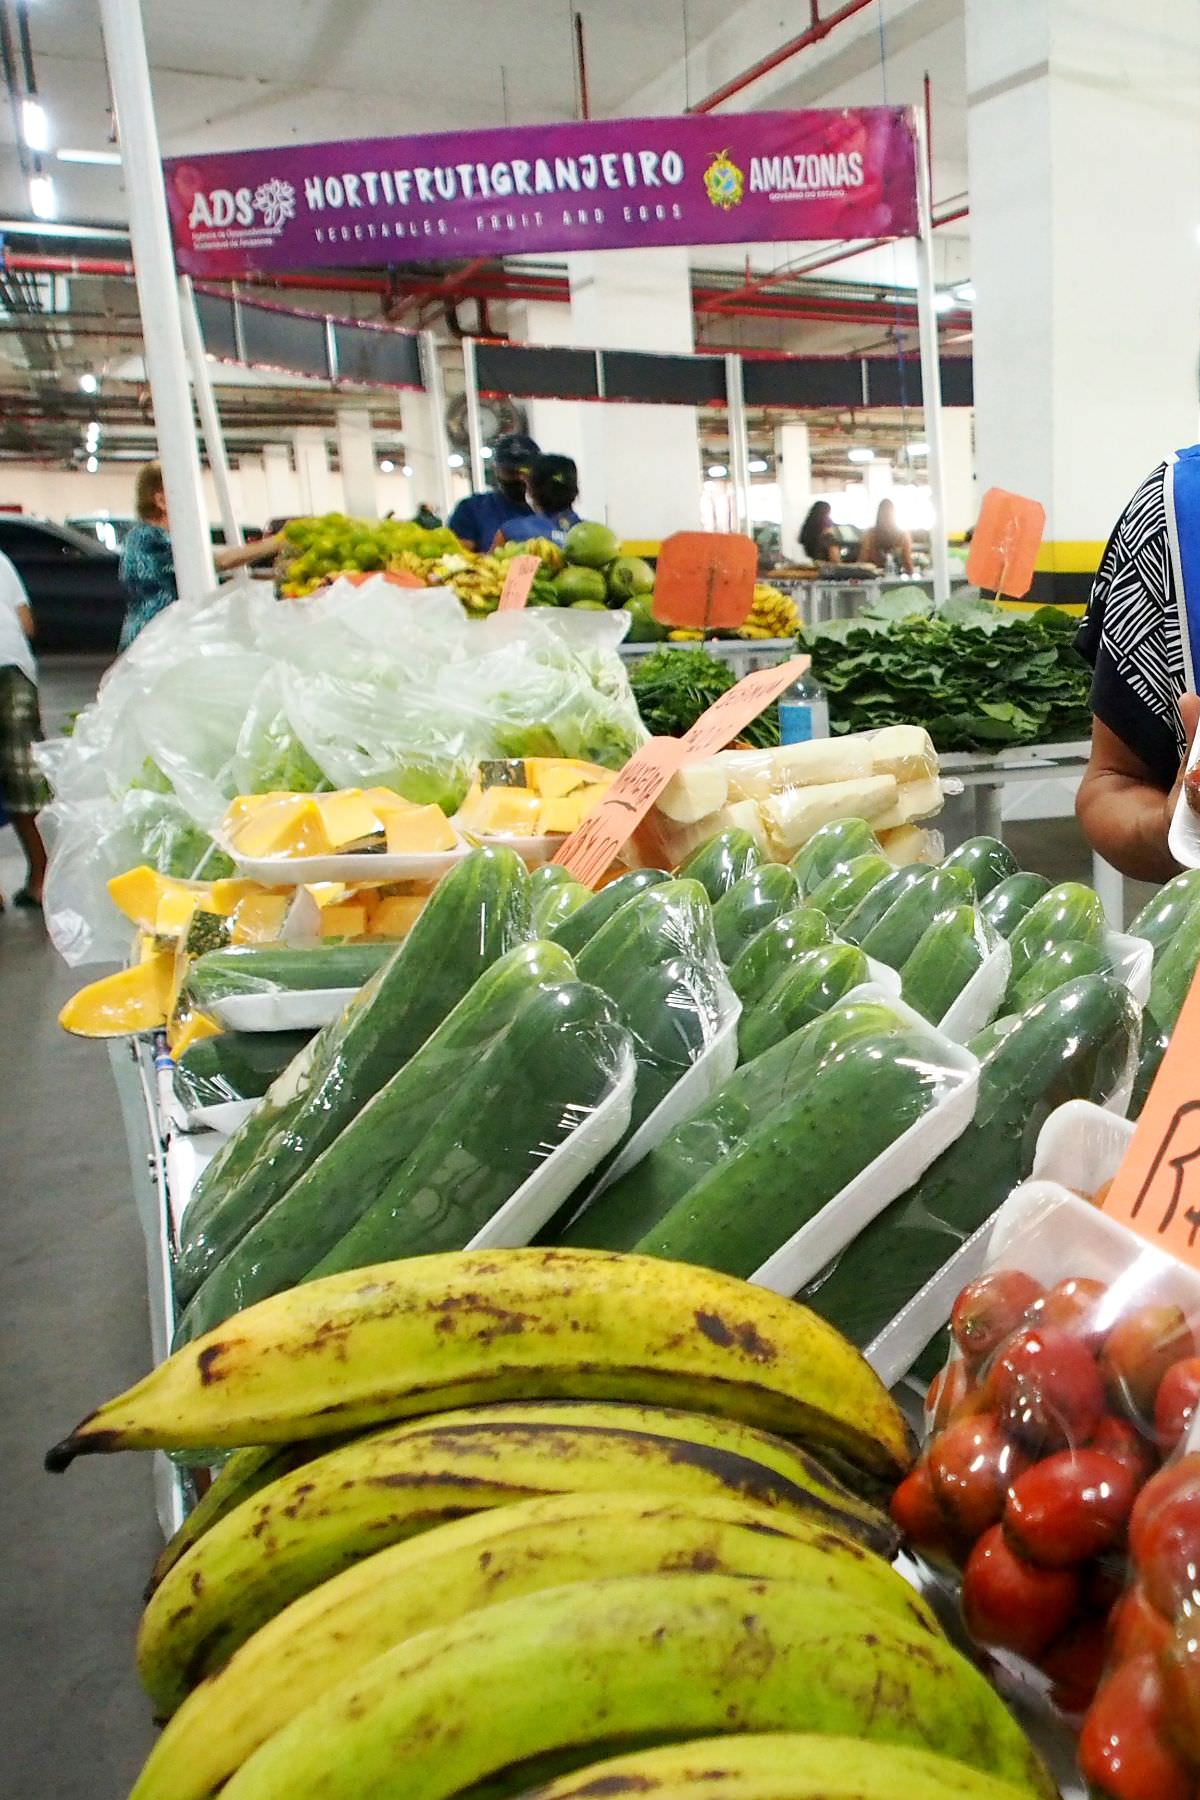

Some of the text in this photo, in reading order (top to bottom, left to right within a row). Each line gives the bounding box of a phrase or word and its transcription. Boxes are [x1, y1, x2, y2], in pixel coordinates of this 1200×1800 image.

[304, 150, 685, 211] HORTIFRUTIGRANJEIRO
[750, 151, 864, 193] AMAZONAS
[188, 187, 255, 229] ADS
[476, 211, 543, 232] FRUIT
[562, 207, 605, 225] AND
[623, 203, 682, 223] EGGS
